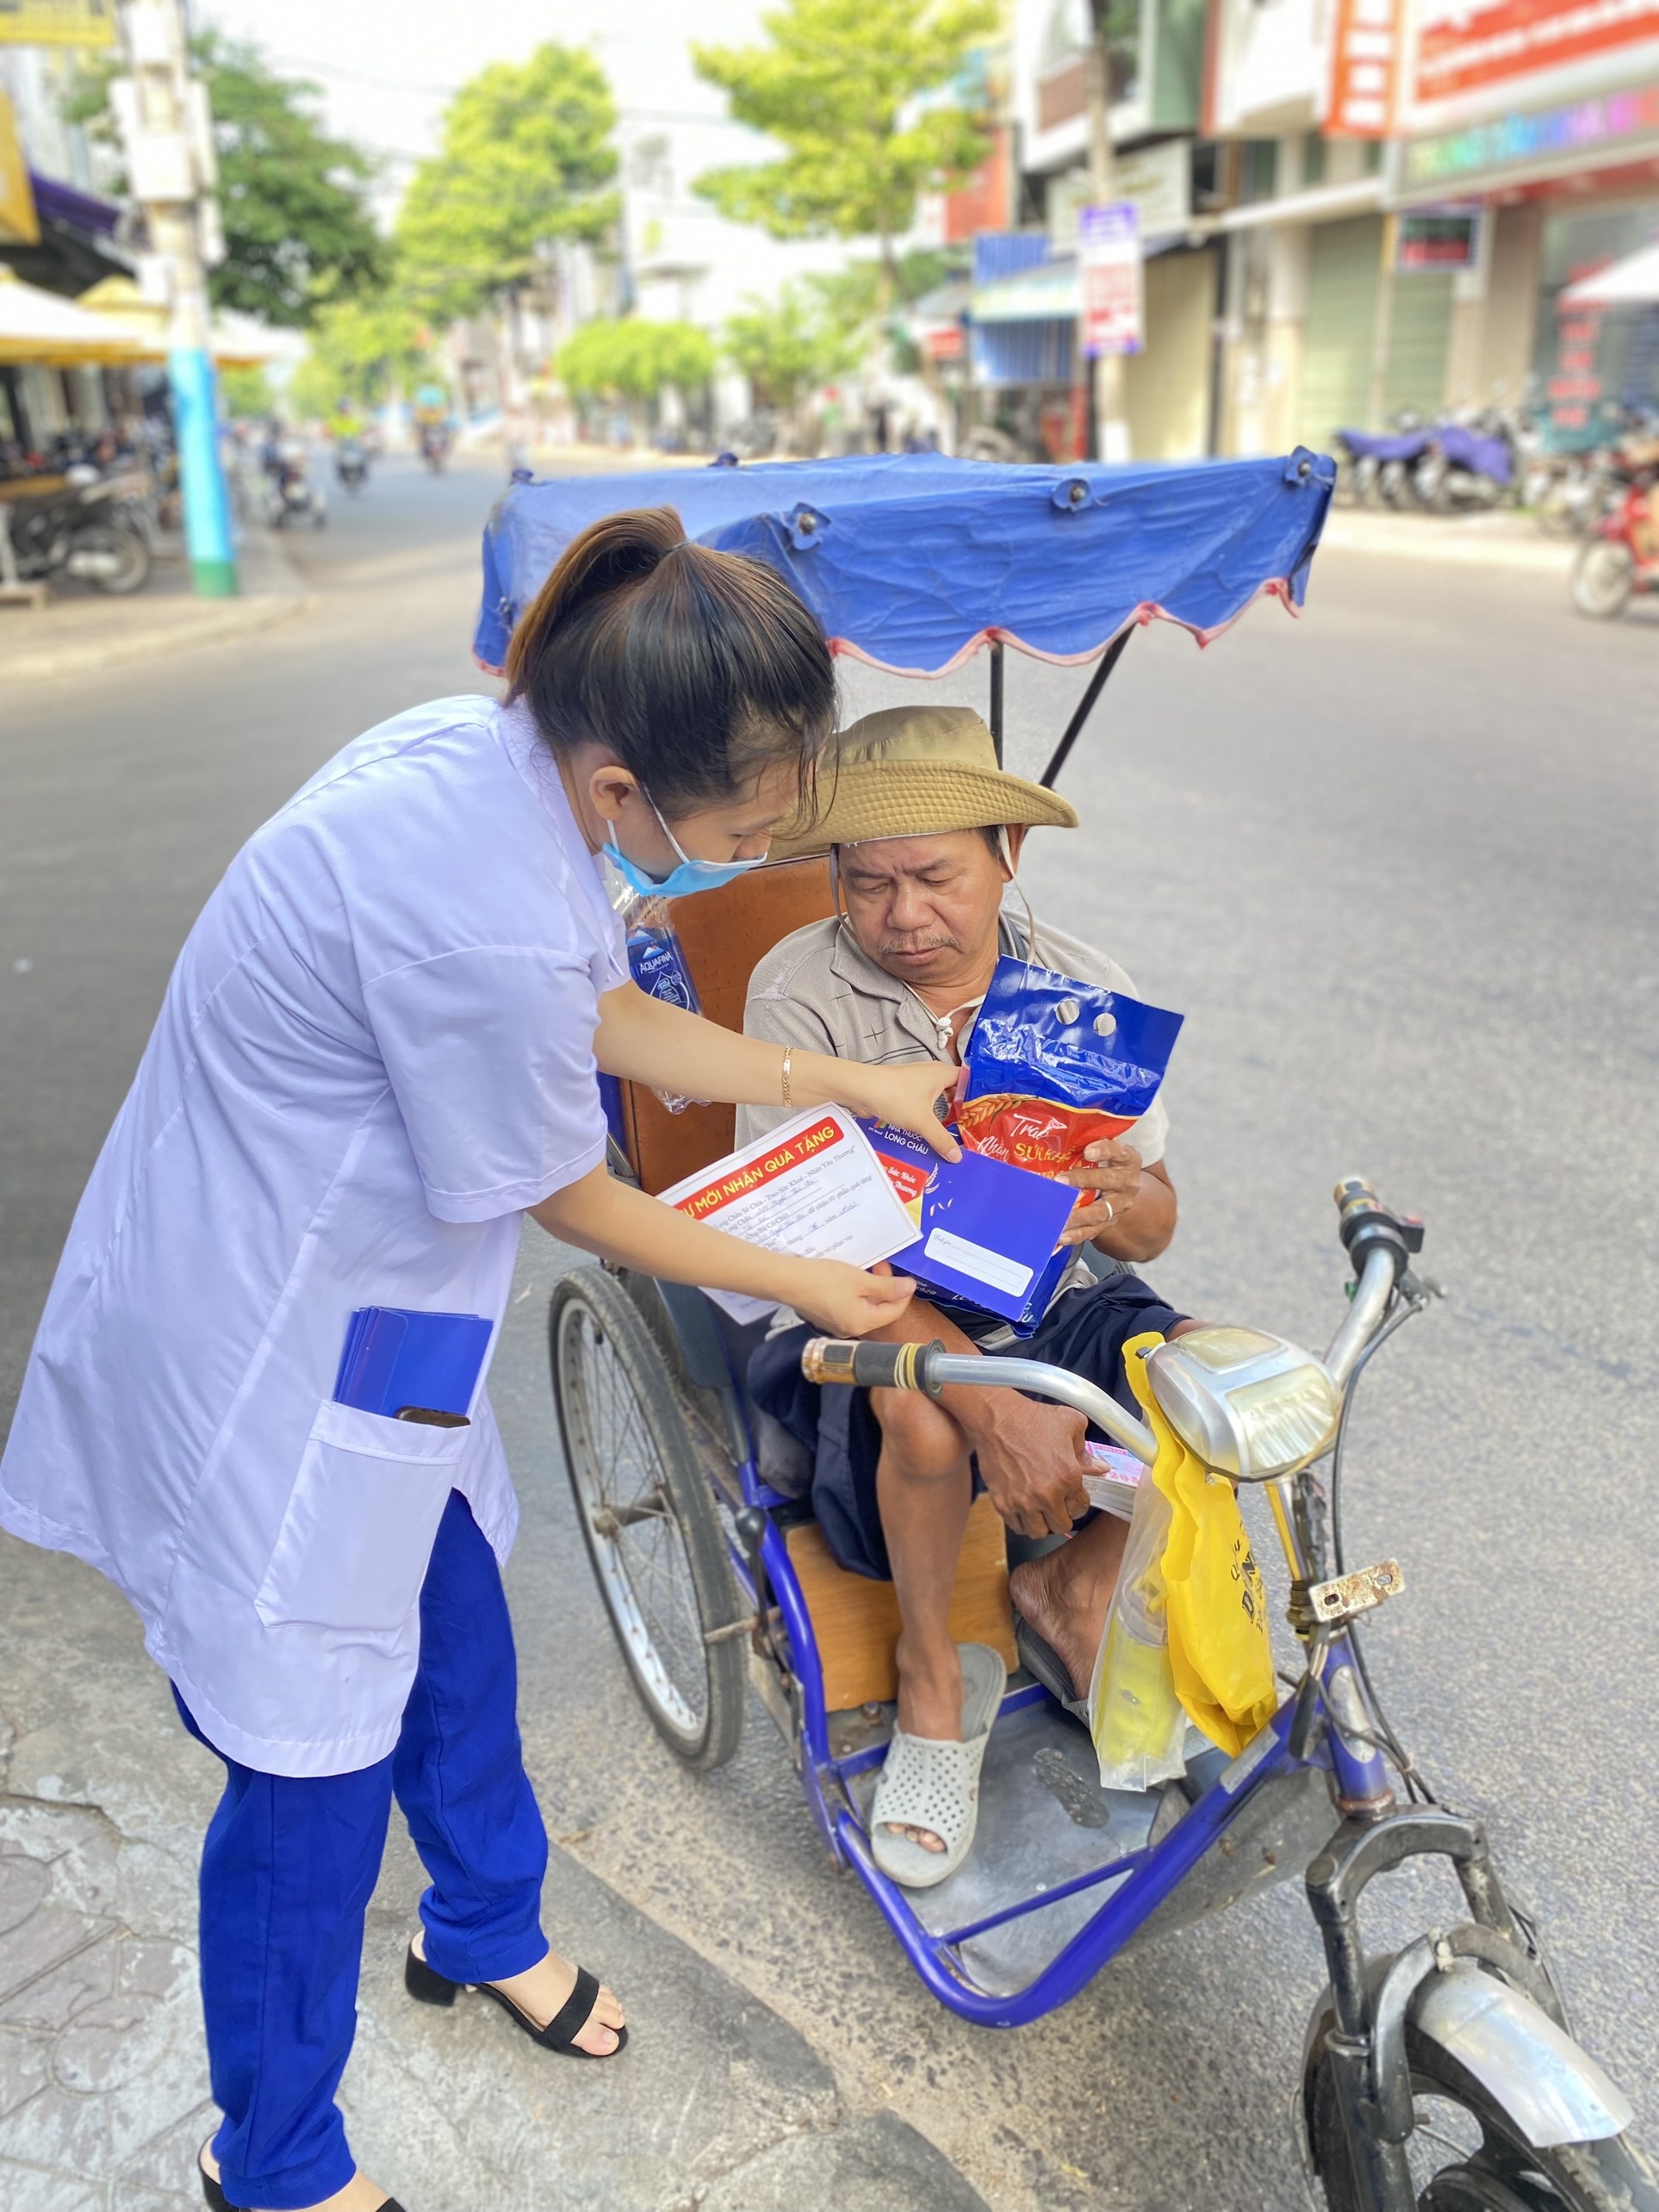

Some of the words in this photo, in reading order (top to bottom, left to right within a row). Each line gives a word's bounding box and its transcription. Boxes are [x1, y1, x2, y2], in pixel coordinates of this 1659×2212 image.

[639, 951, 673, 974] AQUAFINA
[884, 1130, 906, 1146] LONG
[905, 1138, 929, 1154] CHÂU
[695, 1192, 723, 1215] MỜI
[725, 1166, 764, 1198] NHẬN
[764, 1149, 796, 1173] QUÀ
[794, 1125, 836, 1154] TẶNG
